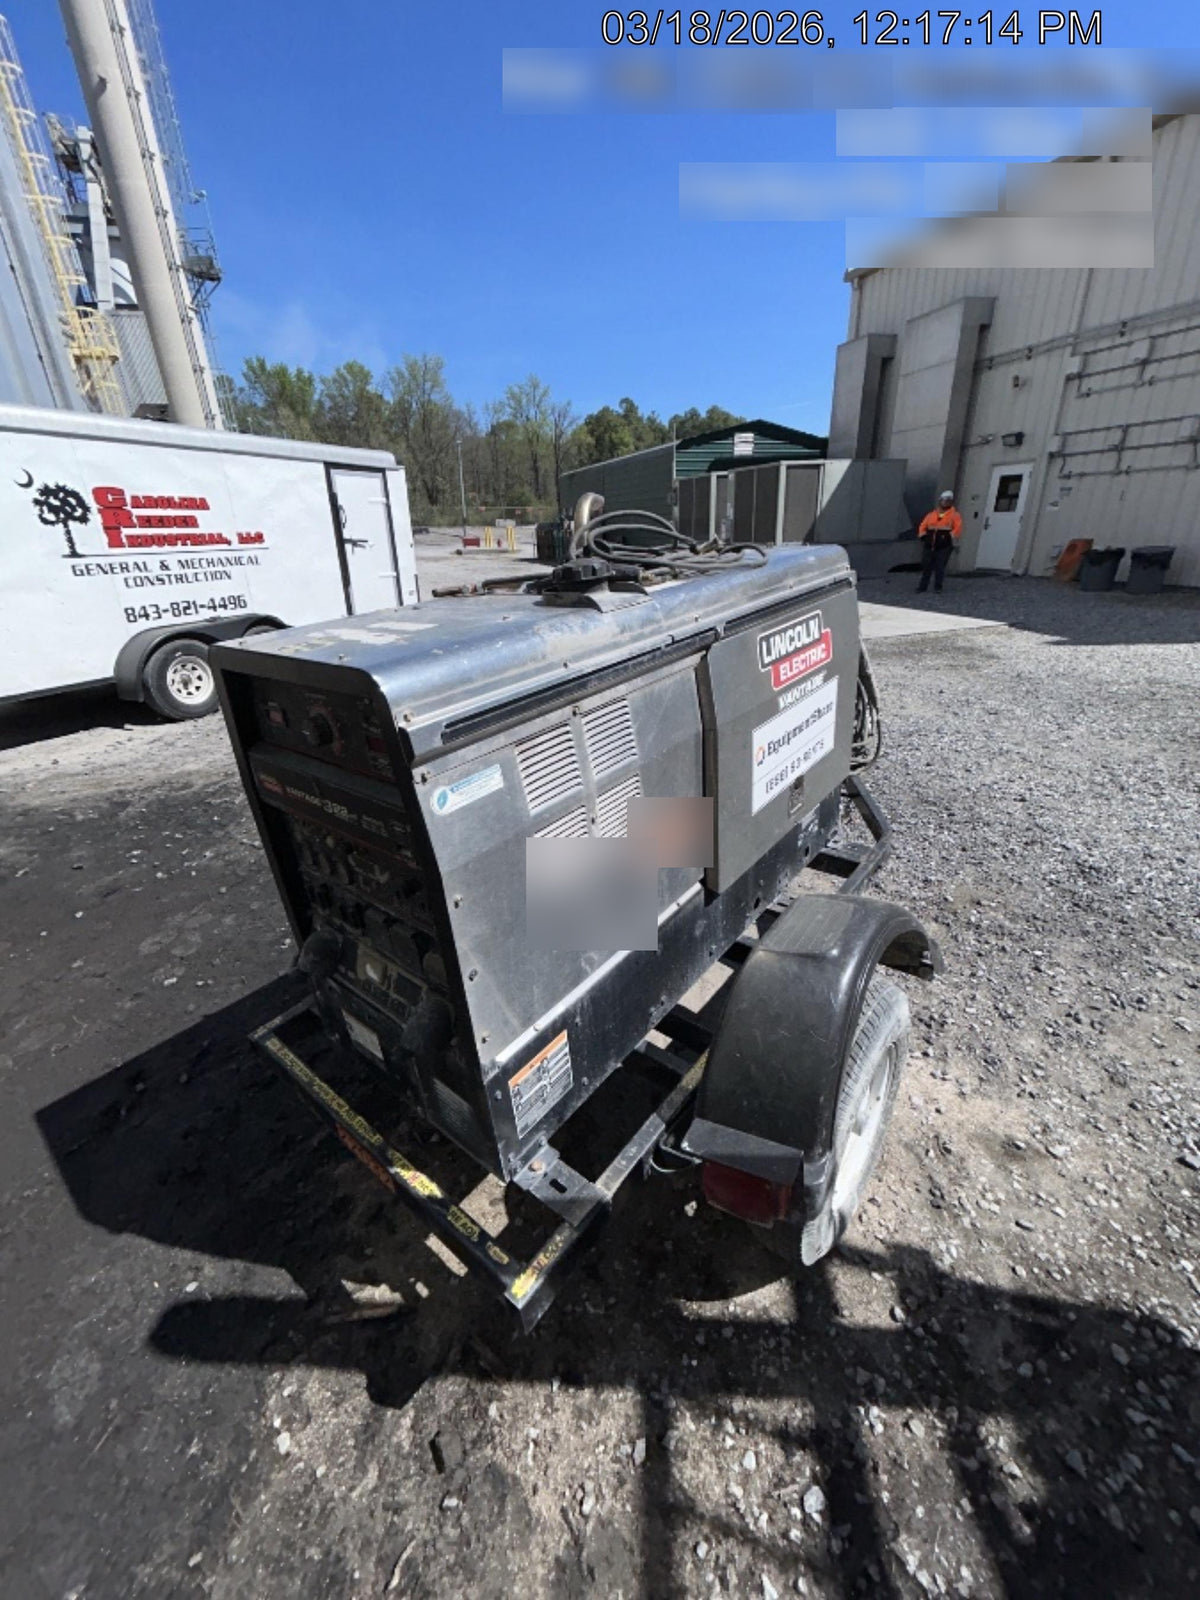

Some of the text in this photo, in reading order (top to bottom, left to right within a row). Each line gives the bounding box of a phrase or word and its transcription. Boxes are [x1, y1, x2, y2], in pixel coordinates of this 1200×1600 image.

[92, 487, 210, 511] CAROLINA
[98, 507, 200, 528] REEDER
[237, 531, 266, 545] LLC
[71, 554, 261, 577] GENERAL & MECHANICAL
[123, 570, 233, 589] CONSTRUCTION
[124, 594, 248, 623] 843-821-4496
[762, 617, 820, 664] LINCOLN
[780, 643, 827, 682] ELECTRIC
